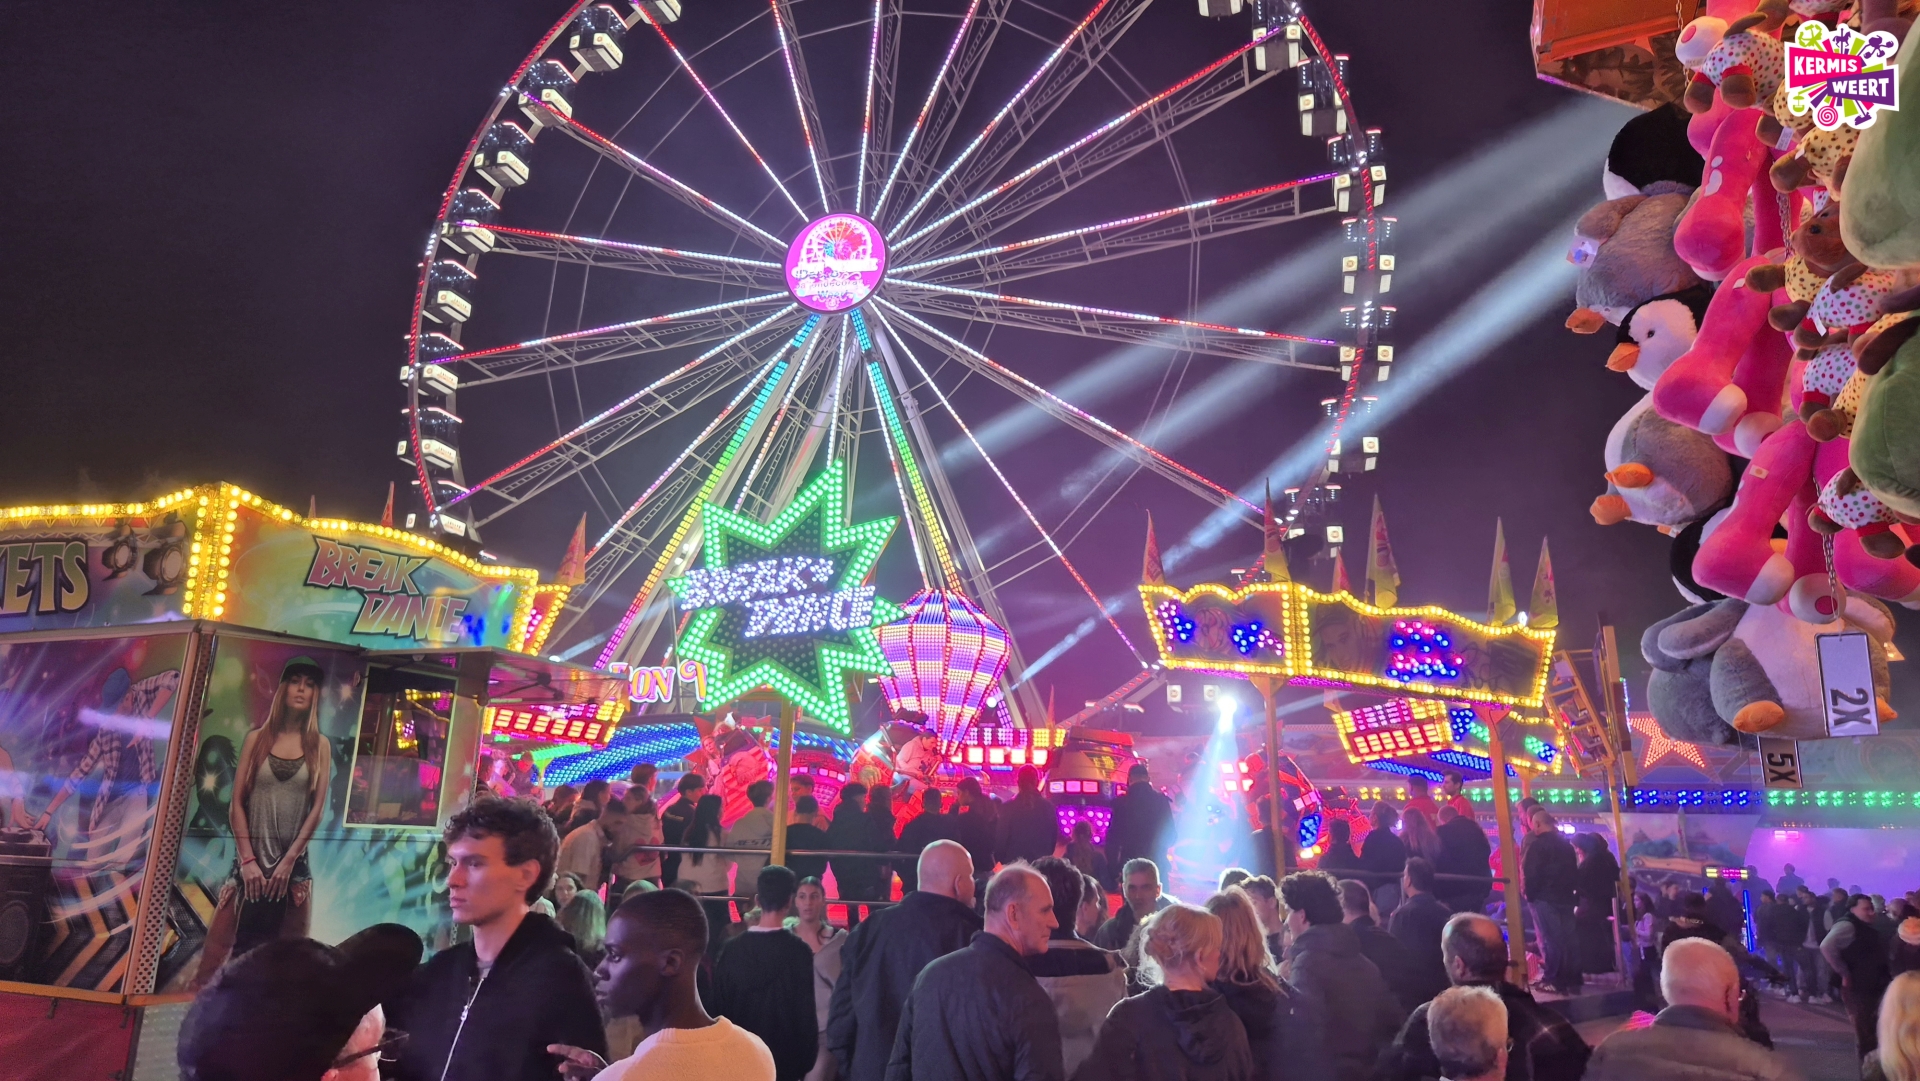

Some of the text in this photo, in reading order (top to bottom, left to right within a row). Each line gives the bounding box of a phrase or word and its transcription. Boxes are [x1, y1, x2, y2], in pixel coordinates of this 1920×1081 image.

[0, 541, 89, 615] ETS
[304, 535, 431, 595] BREAK
[351, 592, 470, 643] DANCE
[744, 585, 877, 638] DANCE
[1830, 687, 1872, 726] 2X
[1766, 752, 1797, 784] 5X
